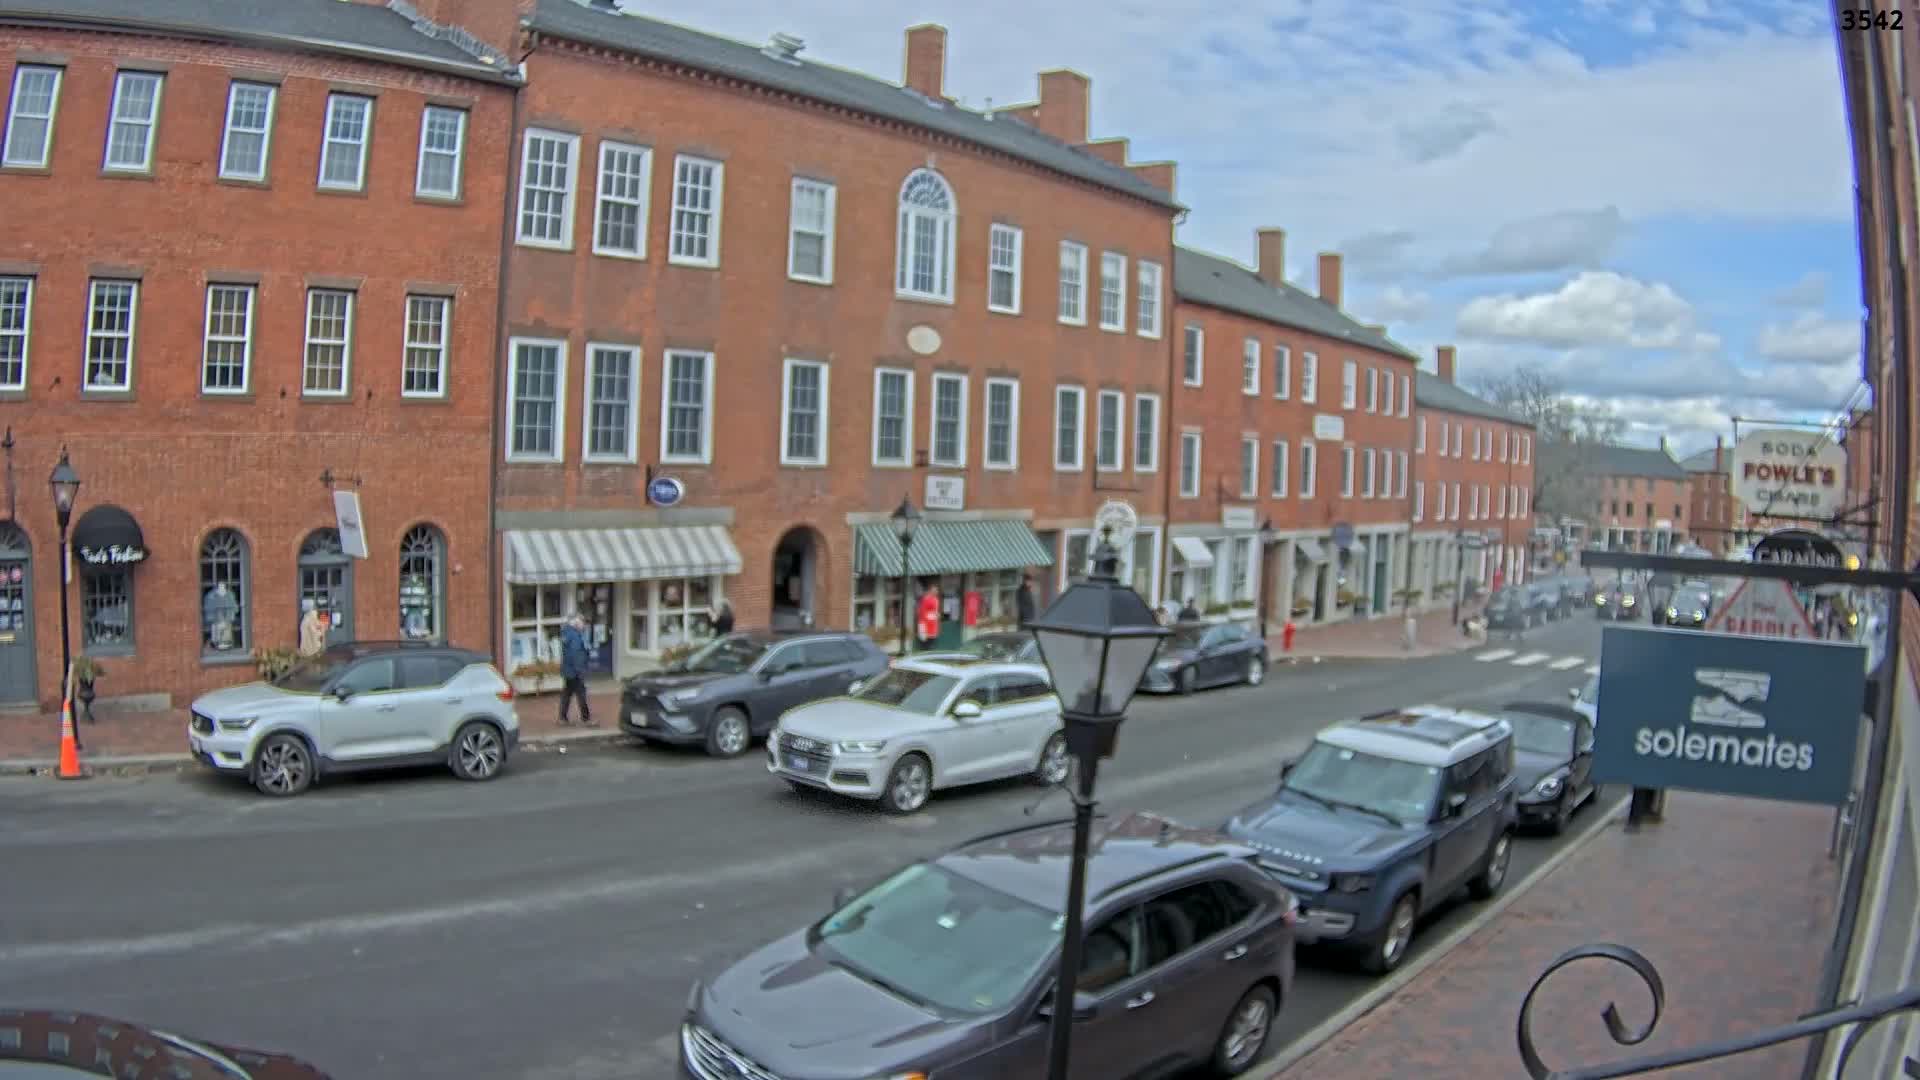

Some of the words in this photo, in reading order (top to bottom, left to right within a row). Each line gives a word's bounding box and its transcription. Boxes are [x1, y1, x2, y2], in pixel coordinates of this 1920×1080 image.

[1761, 441, 1818, 457] SODA
[1743, 462, 1835, 487] FOWLE'S
[1635, 724, 1814, 771] solemates
